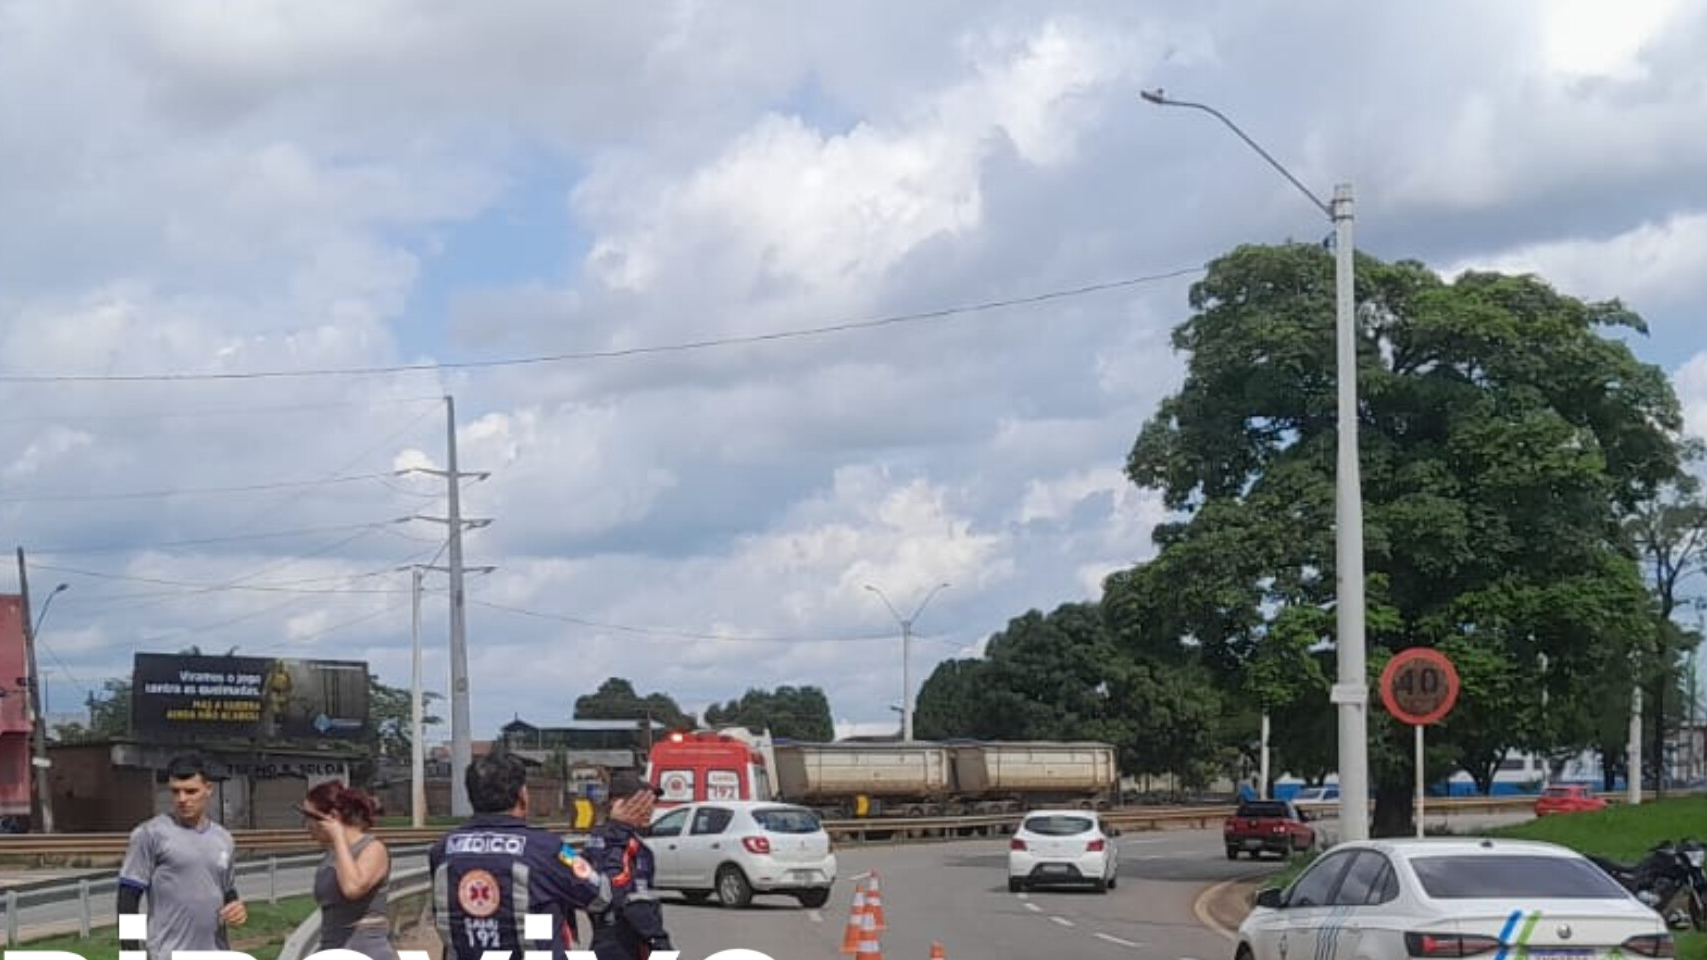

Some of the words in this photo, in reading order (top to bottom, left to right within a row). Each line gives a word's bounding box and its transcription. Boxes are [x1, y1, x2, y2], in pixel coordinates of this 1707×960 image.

[1395, 668, 1439, 695] 40
[713, 786, 735, 798] 192
[466, 929, 500, 948] 192
